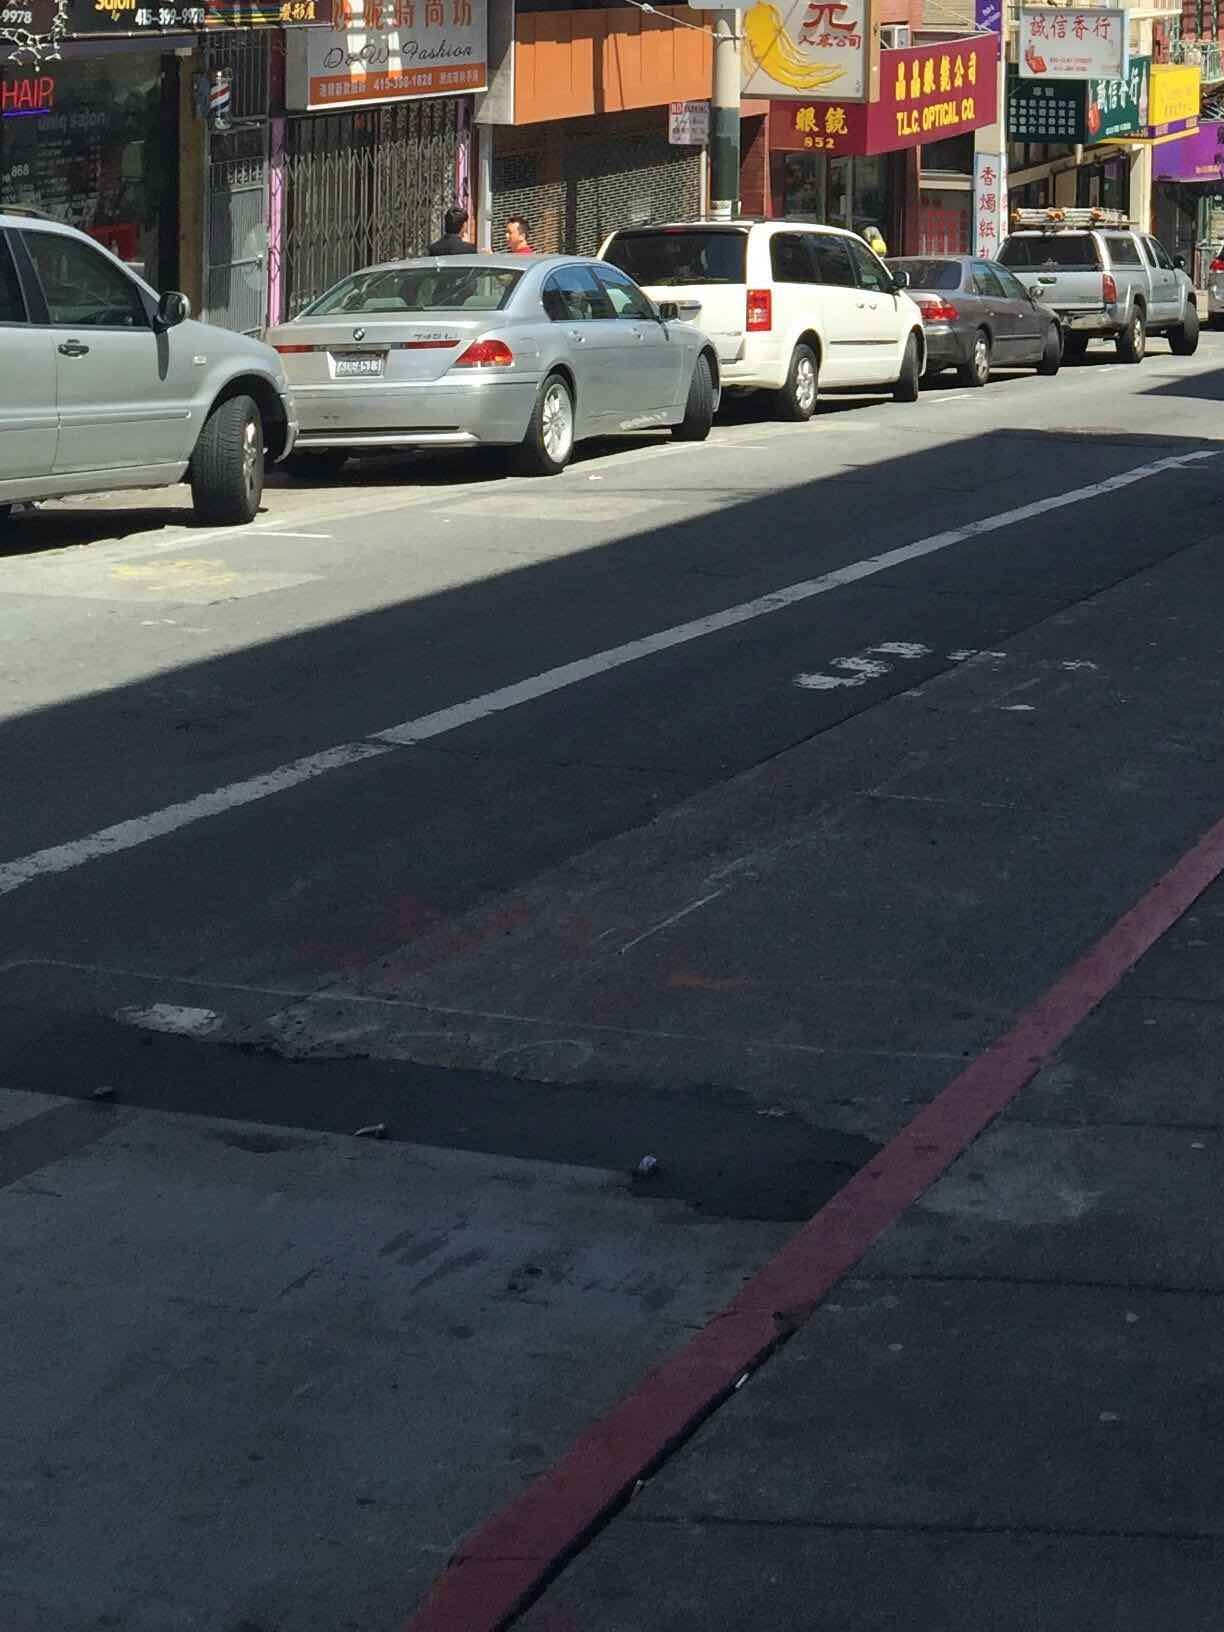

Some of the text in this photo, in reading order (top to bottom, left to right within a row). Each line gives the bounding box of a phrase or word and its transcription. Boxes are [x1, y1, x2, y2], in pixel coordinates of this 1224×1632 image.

[402, 39, 473, 61] Fashion
[2, 77, 55, 110] HAIR
[796, 106, 849, 135] 眼鏡
[922, 101, 960, 131] OPTICAL
